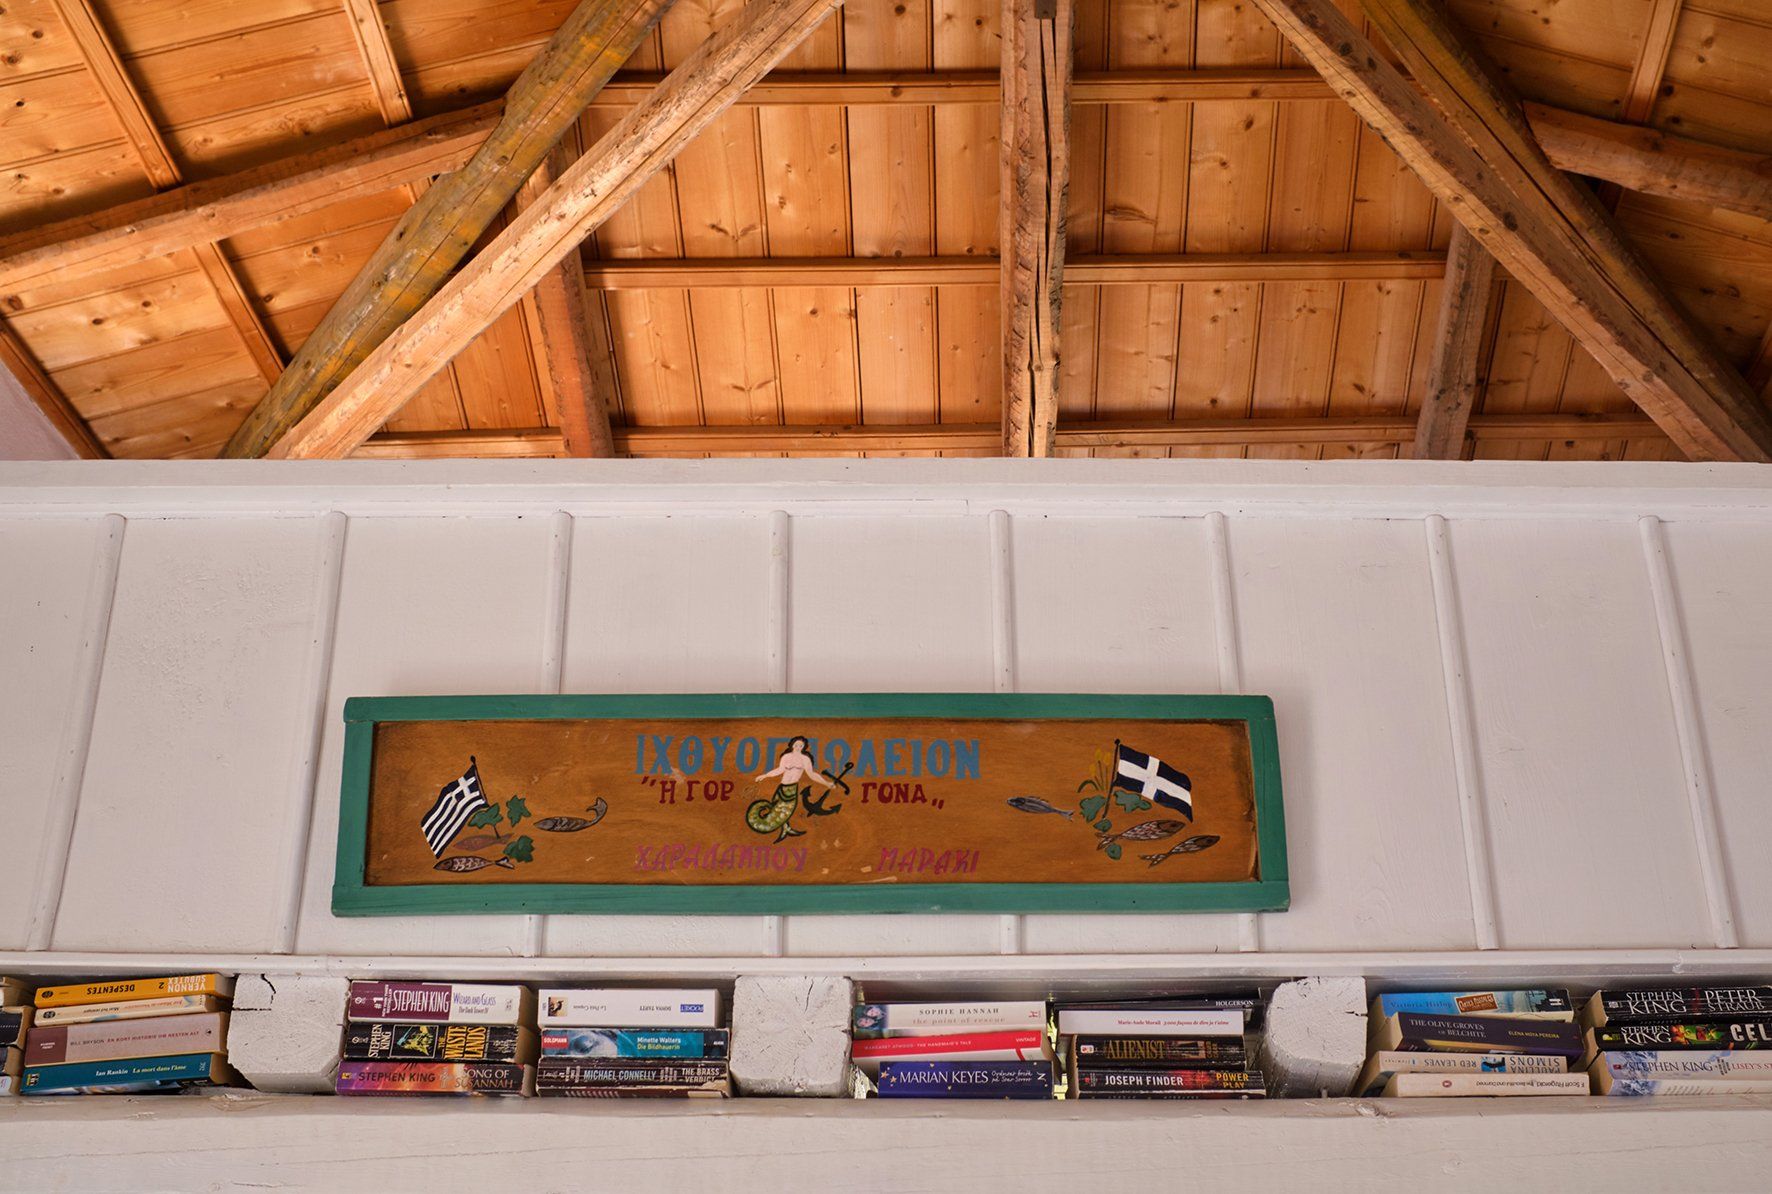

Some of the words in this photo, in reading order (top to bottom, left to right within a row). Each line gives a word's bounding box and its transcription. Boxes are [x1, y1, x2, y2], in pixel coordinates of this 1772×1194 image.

[87, 984, 135, 995] DESPENTES
[167, 983, 206, 992] VERNON
[393, 990, 429, 1012] STEPHEN
[429, 991, 450, 1012] KING
[1626, 991, 1682, 1001] STEPHEN
[1704, 989, 1761, 1003] PETER
[372, 997, 384, 1009] #1
[1627, 1000, 1687, 1014] KING
[1708, 1001, 1764, 1011] STRAUB
[1427, 1020, 1451, 1028] OLIVE
[1452, 1022, 1485, 1030] GROVES
[1620, 1026, 1669, 1034] STEPHEN
[1447, 1029, 1487, 1038] BELCHITE
[1621, 1032, 1672, 1046] KING
[368, 1024, 383, 1058] STEPHEN
[380, 1031, 392, 1051] KING
[444, 1025, 468, 1059] WASTE
[464, 1026, 487, 1058] LANDS
[1107, 1040, 1165, 1059] ALIENIST
[1424, 1058, 1457, 1067] LEAVES
[1460, 1060, 1477, 1068] RED
[1510, 1056, 1560, 1066] SIMONS
[1626, 1062, 1681, 1072] STEPHEN
[1682, 1061, 1713, 1072] KING
[463, 1069, 493, 1079] SONG
[495, 1069, 510, 1078] OF
[584, 1070, 617, 1081] MICHAEL
[619, 1070, 656, 1081] CONNELLY
[682, 1067, 695, 1075] THE
[1215, 1072, 1249, 1081] POWER
[359, 1072, 406, 1082] STEPHEN
[408, 1072, 436, 1083] KING
[899, 1071, 949, 1083] MARIAN
[952, 1071, 989, 1083] KEYES
[1105, 1075, 1143, 1086] JOSEPH
[1146, 1076, 1184, 1086] FINDER
[455, 1079, 513, 1088] SUSANNAH
[1222, 1081, 1245, 1089] PLAY
